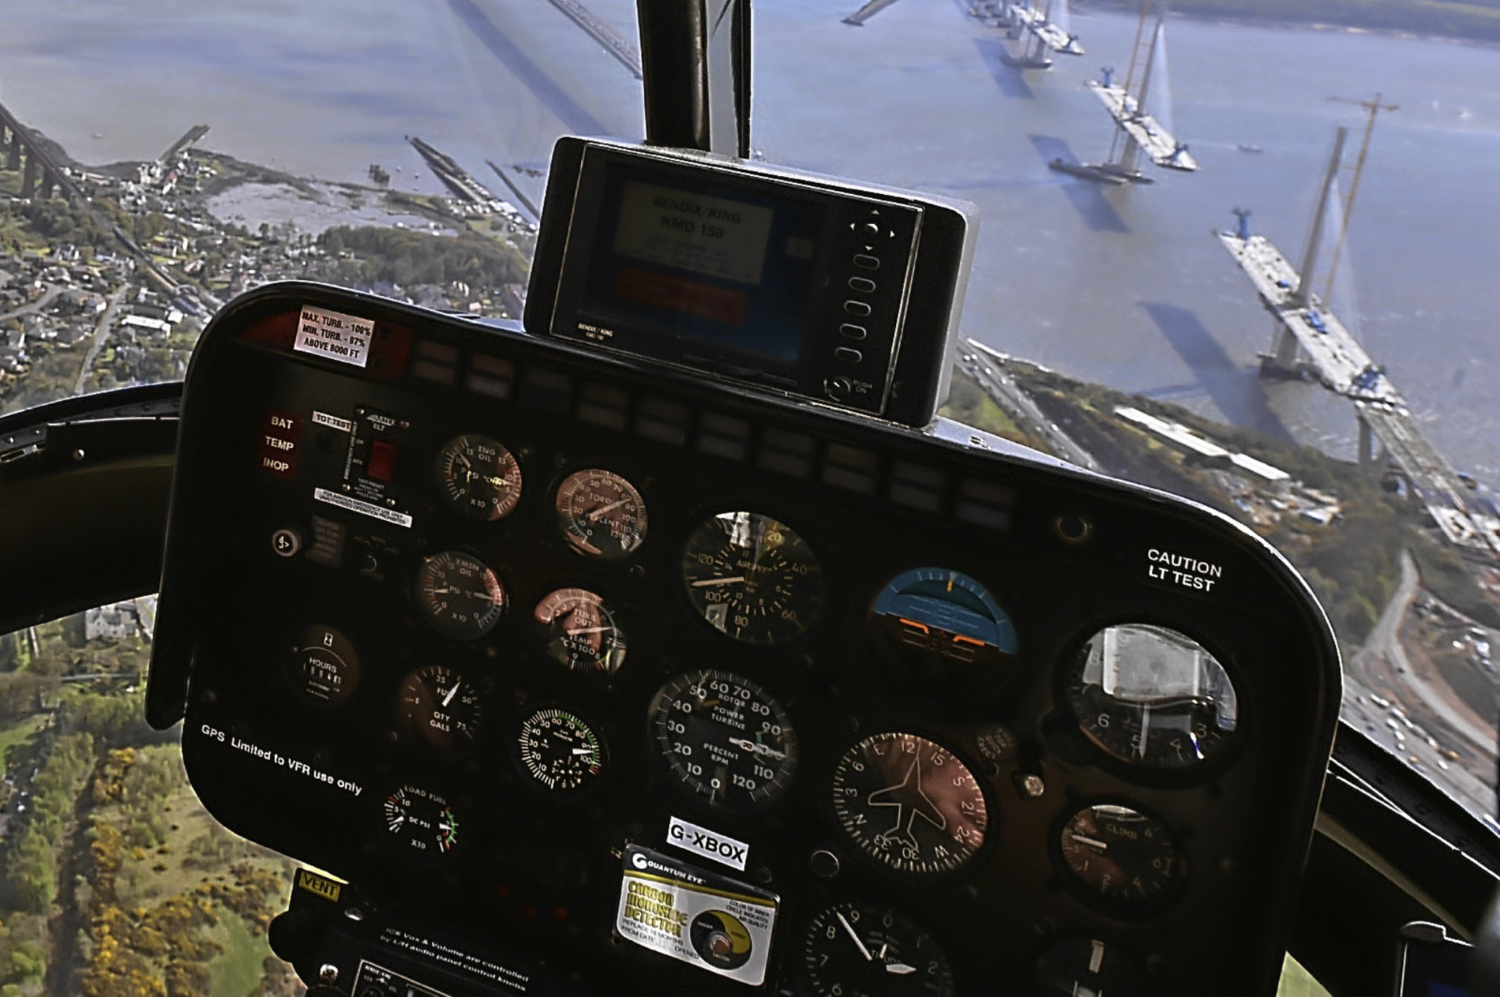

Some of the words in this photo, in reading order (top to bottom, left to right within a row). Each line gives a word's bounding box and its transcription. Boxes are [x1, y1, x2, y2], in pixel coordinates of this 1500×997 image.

[652, 195, 741, 224] BENDIX/KING
[661, 215, 695, 233] KMD
[700, 223, 724, 240] 150
[302, 311, 320, 323] MAX.
[322, 316, 344, 329] TURB.
[351, 324, 371, 336] 100%
[303, 324, 319, 336] MIN.
[321, 328, 342, 342] TURB.
[350, 337, 365, 347] 97%
[304, 337, 329, 351] ABOVE
[330, 343, 348, 355] 8000
[350, 348, 360, 358] FT
[271, 416, 294, 430] BAT
[373, 423, 385, 432] ELT
[265, 435, 294, 452] TEMP
[478, 445, 496, 456] ENG
[263, 457, 289, 472] INOP
[478, 453, 491, 463] OIL
[768, 532, 782, 542] 20
[698, 553, 714, 566] 120
[1147, 548, 1222, 578] CAUTION
[460, 567, 472, 577] OIL
[791, 562, 808, 575] 40
[1148, 564, 1169, 580] LT
[1172, 570, 1215, 592] TEST
[705, 591, 722, 603] 100
[574, 608, 597, 622] TURB
[574, 616, 592, 627] OUT
[734, 615, 749, 628] 80
[781, 609, 797, 621] 60
[309, 656, 338, 674] HOURS
[436, 675, 446, 684] 25
[710, 680, 729, 693] 60
[689, 685, 708, 699] 50
[733, 685, 751, 700] 70
[461, 696, 473, 705] 50
[672, 700, 692, 713] 40
[718, 692, 746, 708] ROTOR
[714, 706, 745, 721] POWER
[751, 702, 770, 716] 80
[433, 711, 451, 722] QTY
[551, 717, 562, 726] 60
[711, 713, 746, 730] TURBINE
[1097, 713, 1110, 728] 6
[430, 719, 450, 732] GALS
[456, 721, 467, 731] 75
[532, 728, 541, 736] 40
[565, 721, 575, 730] 70
[667, 720, 685, 734] 30
[761, 721, 781, 736] 90
[1196, 723, 1207, 739] 3
[575, 730, 586, 739] 80
[529, 739, 538, 748] 30
[673, 742, 692, 756] 20
[873, 744, 884, 756] E
[901, 741, 915, 754] 12
[532, 752, 541, 761] 20
[703, 743, 739, 760] PERCENT
[201, 724, 225, 742] GPS
[231, 737, 272, 761] Limited
[273, 753, 285, 765] to
[288, 758, 311, 776] VFR
[313, 770, 334, 784] use
[337, 779, 362, 796] only
[580, 755, 592, 764] 100
[711, 754, 729, 766] RPM
[930, 752, 945, 766] 15
[539, 763, 547, 771] 10
[687, 762, 702, 776] 10
[753, 765, 774, 780] 110
[852, 761, 865, 772] 6
[710, 778, 721, 789] 0
[732, 774, 756, 790] 120
[404, 785, 427, 797] LOAD
[429, 793, 447, 805] FUEL
[845, 788, 858, 797] 3
[962, 801, 975, 815] 21
[853, 813, 867, 825] N
[953, 826, 970, 844] 24
[1106, 823, 1138, 841] CLIMB
[671, 824, 745, 863] G-XBOX
[873, 834, 892, 851] 33
[902, 847, 919, 861] 30
[934, 845, 950, 859] W
[647, 861, 686, 878] QUANTUM
[687, 874, 702, 885] EYE
[302, 872, 337, 896] VENT
[628, 881, 674, 907] CARBON
[626, 893, 688, 926] MONOXIDE
[850, 910, 860, 922] 9
[624, 905, 682, 937] DETECTOR
[883, 914, 893, 928] 0
[621, 925, 639, 935] FROM
[640, 933, 654, 942] DATE
[826, 925, 836, 939] 8
[380, 935, 391, 944] by
[410, 945, 435, 957] audio
[436, 954, 462, 968] panel
[463, 963, 497, 980] control
[497, 976, 526, 992] knobs
[403, 932, 420, 942] Vox
[431, 941, 464, 957] Volume
[466, 955, 481, 963] are
[482, 960, 529, 982] controlled
[820, 953, 829, 967] 7
[927, 961, 939, 975] 2
[832, 983, 842, 996] 6
